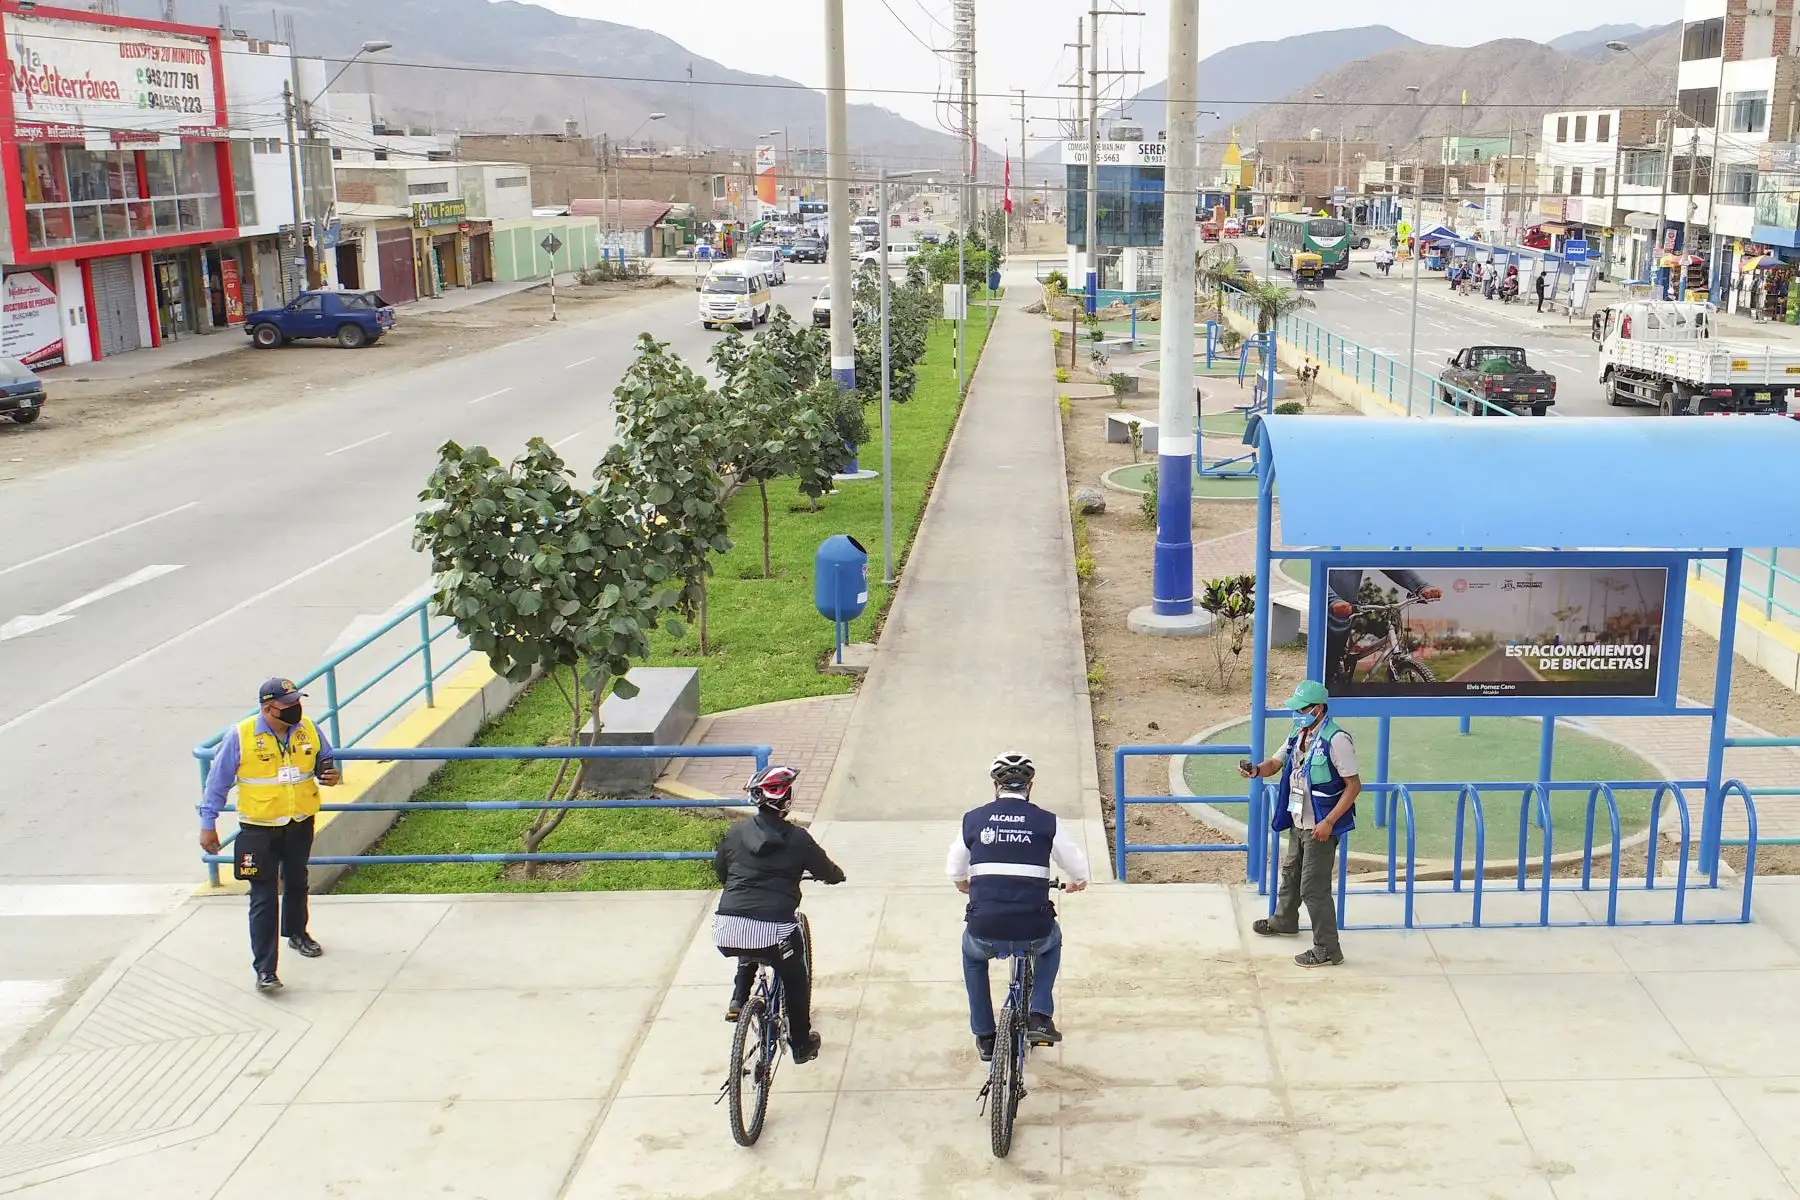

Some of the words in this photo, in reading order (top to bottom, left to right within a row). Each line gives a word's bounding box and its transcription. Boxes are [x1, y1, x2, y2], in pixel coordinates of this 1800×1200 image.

[25, 47, 41, 73] La
[171, 48, 206, 66] MINUTOS
[10, 59, 120, 110] Mediterránea
[162, 70, 179, 89] 277
[180, 71, 200, 90] 791
[182, 96, 203, 114] 223
[1074, 152, 1088, 162] (01)
[427, 203, 438, 218] Tu
[439, 202, 465, 217] Farma
[1505, 644, 1645, 657] ESTACIONAMIENTO
[1539, 658, 1560, 670] DE
[1562, 658, 1643, 670] BICICLETAS
[989, 814, 1026, 822] ALCALDE
[998, 833, 1032, 843] LIMA
[240, 867, 258, 876] MDP
